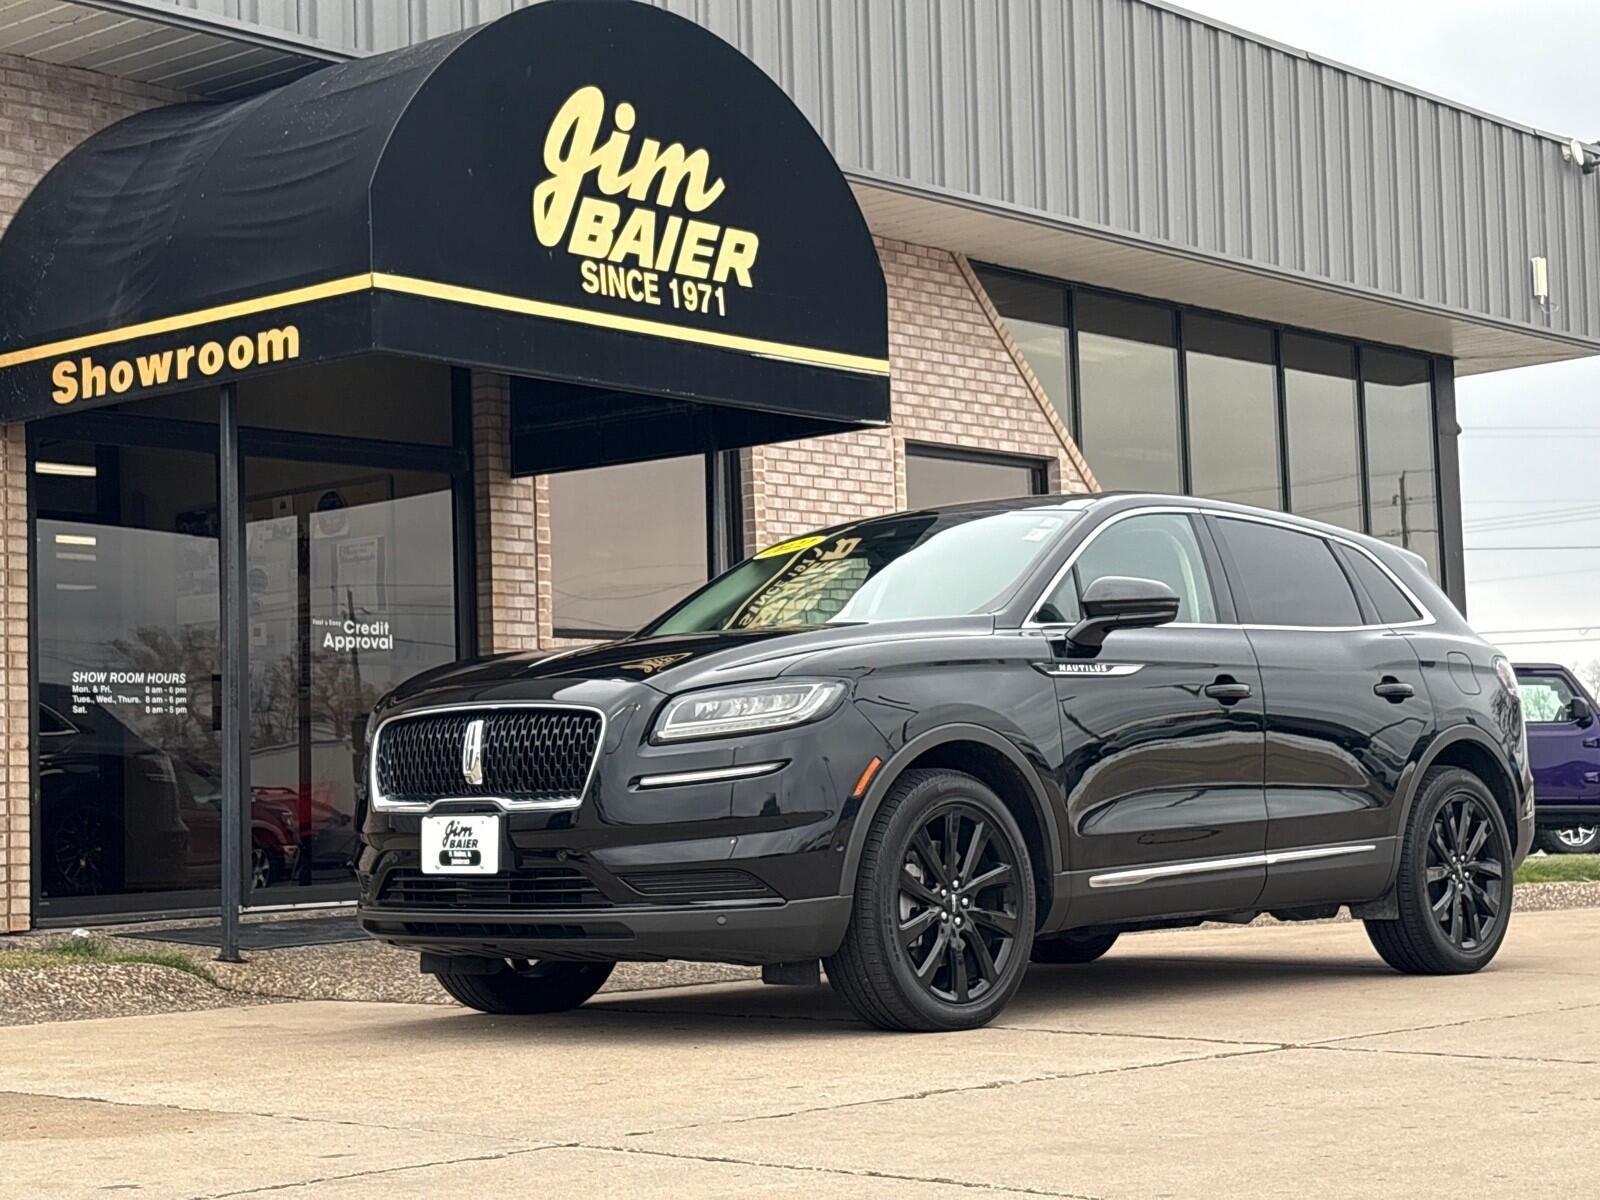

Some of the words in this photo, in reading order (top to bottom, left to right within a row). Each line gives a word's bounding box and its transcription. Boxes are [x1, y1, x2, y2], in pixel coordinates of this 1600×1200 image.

[532, 84, 726, 248] Jim
[567, 196, 759, 288] BAIER
[580, 260, 661, 305] SINCE
[669, 278, 726, 317] 1971
[51, 325, 300, 405] Showroom
[343, 620, 389, 635] Credit
[323, 632, 393, 652] Approval
[1059, 664, 1107, 672] NAUTILUS
[72, 671, 107, 683] SHOW
[109, 672, 145, 684] ROOM
[147, 673, 187, 684] HOURS
[72, 685, 91, 694] Mon.
[92, 685, 98, 694] &
[100, 685, 112, 694] Fri.
[72, 705, 88, 714] Sat.
[442, 820, 473, 848] Jim
[449, 839, 479, 848] BAIER
